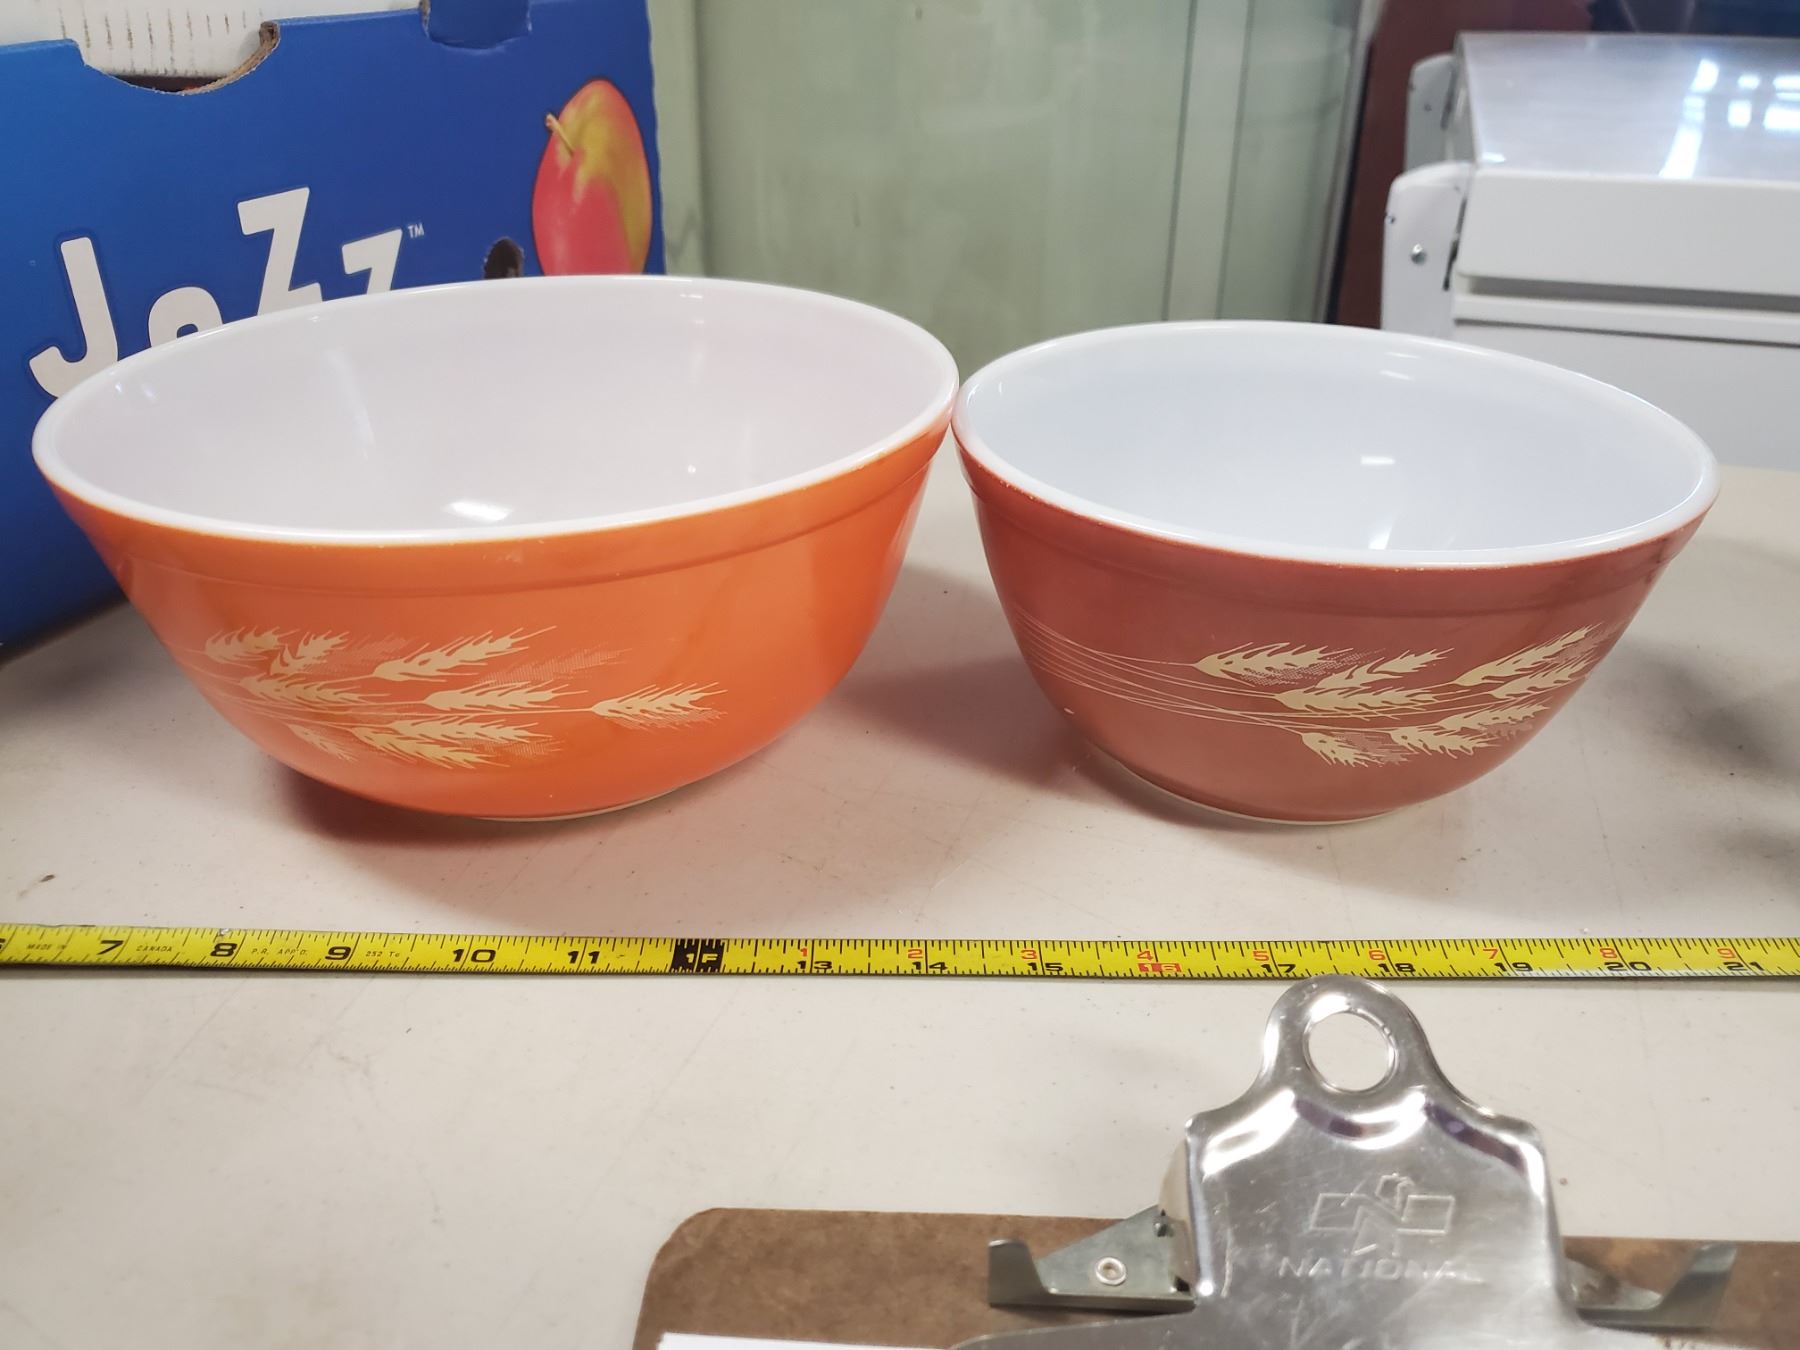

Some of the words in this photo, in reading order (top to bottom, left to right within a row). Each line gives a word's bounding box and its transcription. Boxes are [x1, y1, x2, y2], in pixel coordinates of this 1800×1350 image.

[97, 940, 124, 955] 7
[209, 943, 238, 957] 8
[325, 946, 351, 960] 9
[800, 948, 807, 957] 1
[452, 949, 496, 963] 10
[567, 951, 600, 964] 11
[907, 948, 923, 959] 2
[1021, 949, 1037, 960] 3
[1137, 950, 1153, 961] 4
[1253, 950, 1269, 961] 5
[1369, 950, 1386, 961] 6
[1482, 948, 1498, 959] 7
[1600, 948, 1618, 959] 8
[1717, 948, 1736, 959] 9
[797, 960, 832, 970] 13
[911, 961, 948, 971] 14
[1027, 962, 1064, 972] 15
[1261, 963, 1296, 973] 17
[1377, 963, 1415, 972] 18
[1494, 962, 1533, 972] 19
[1604, 962, 1651, 972] 20
[1723, 961, 1765, 972] 21
